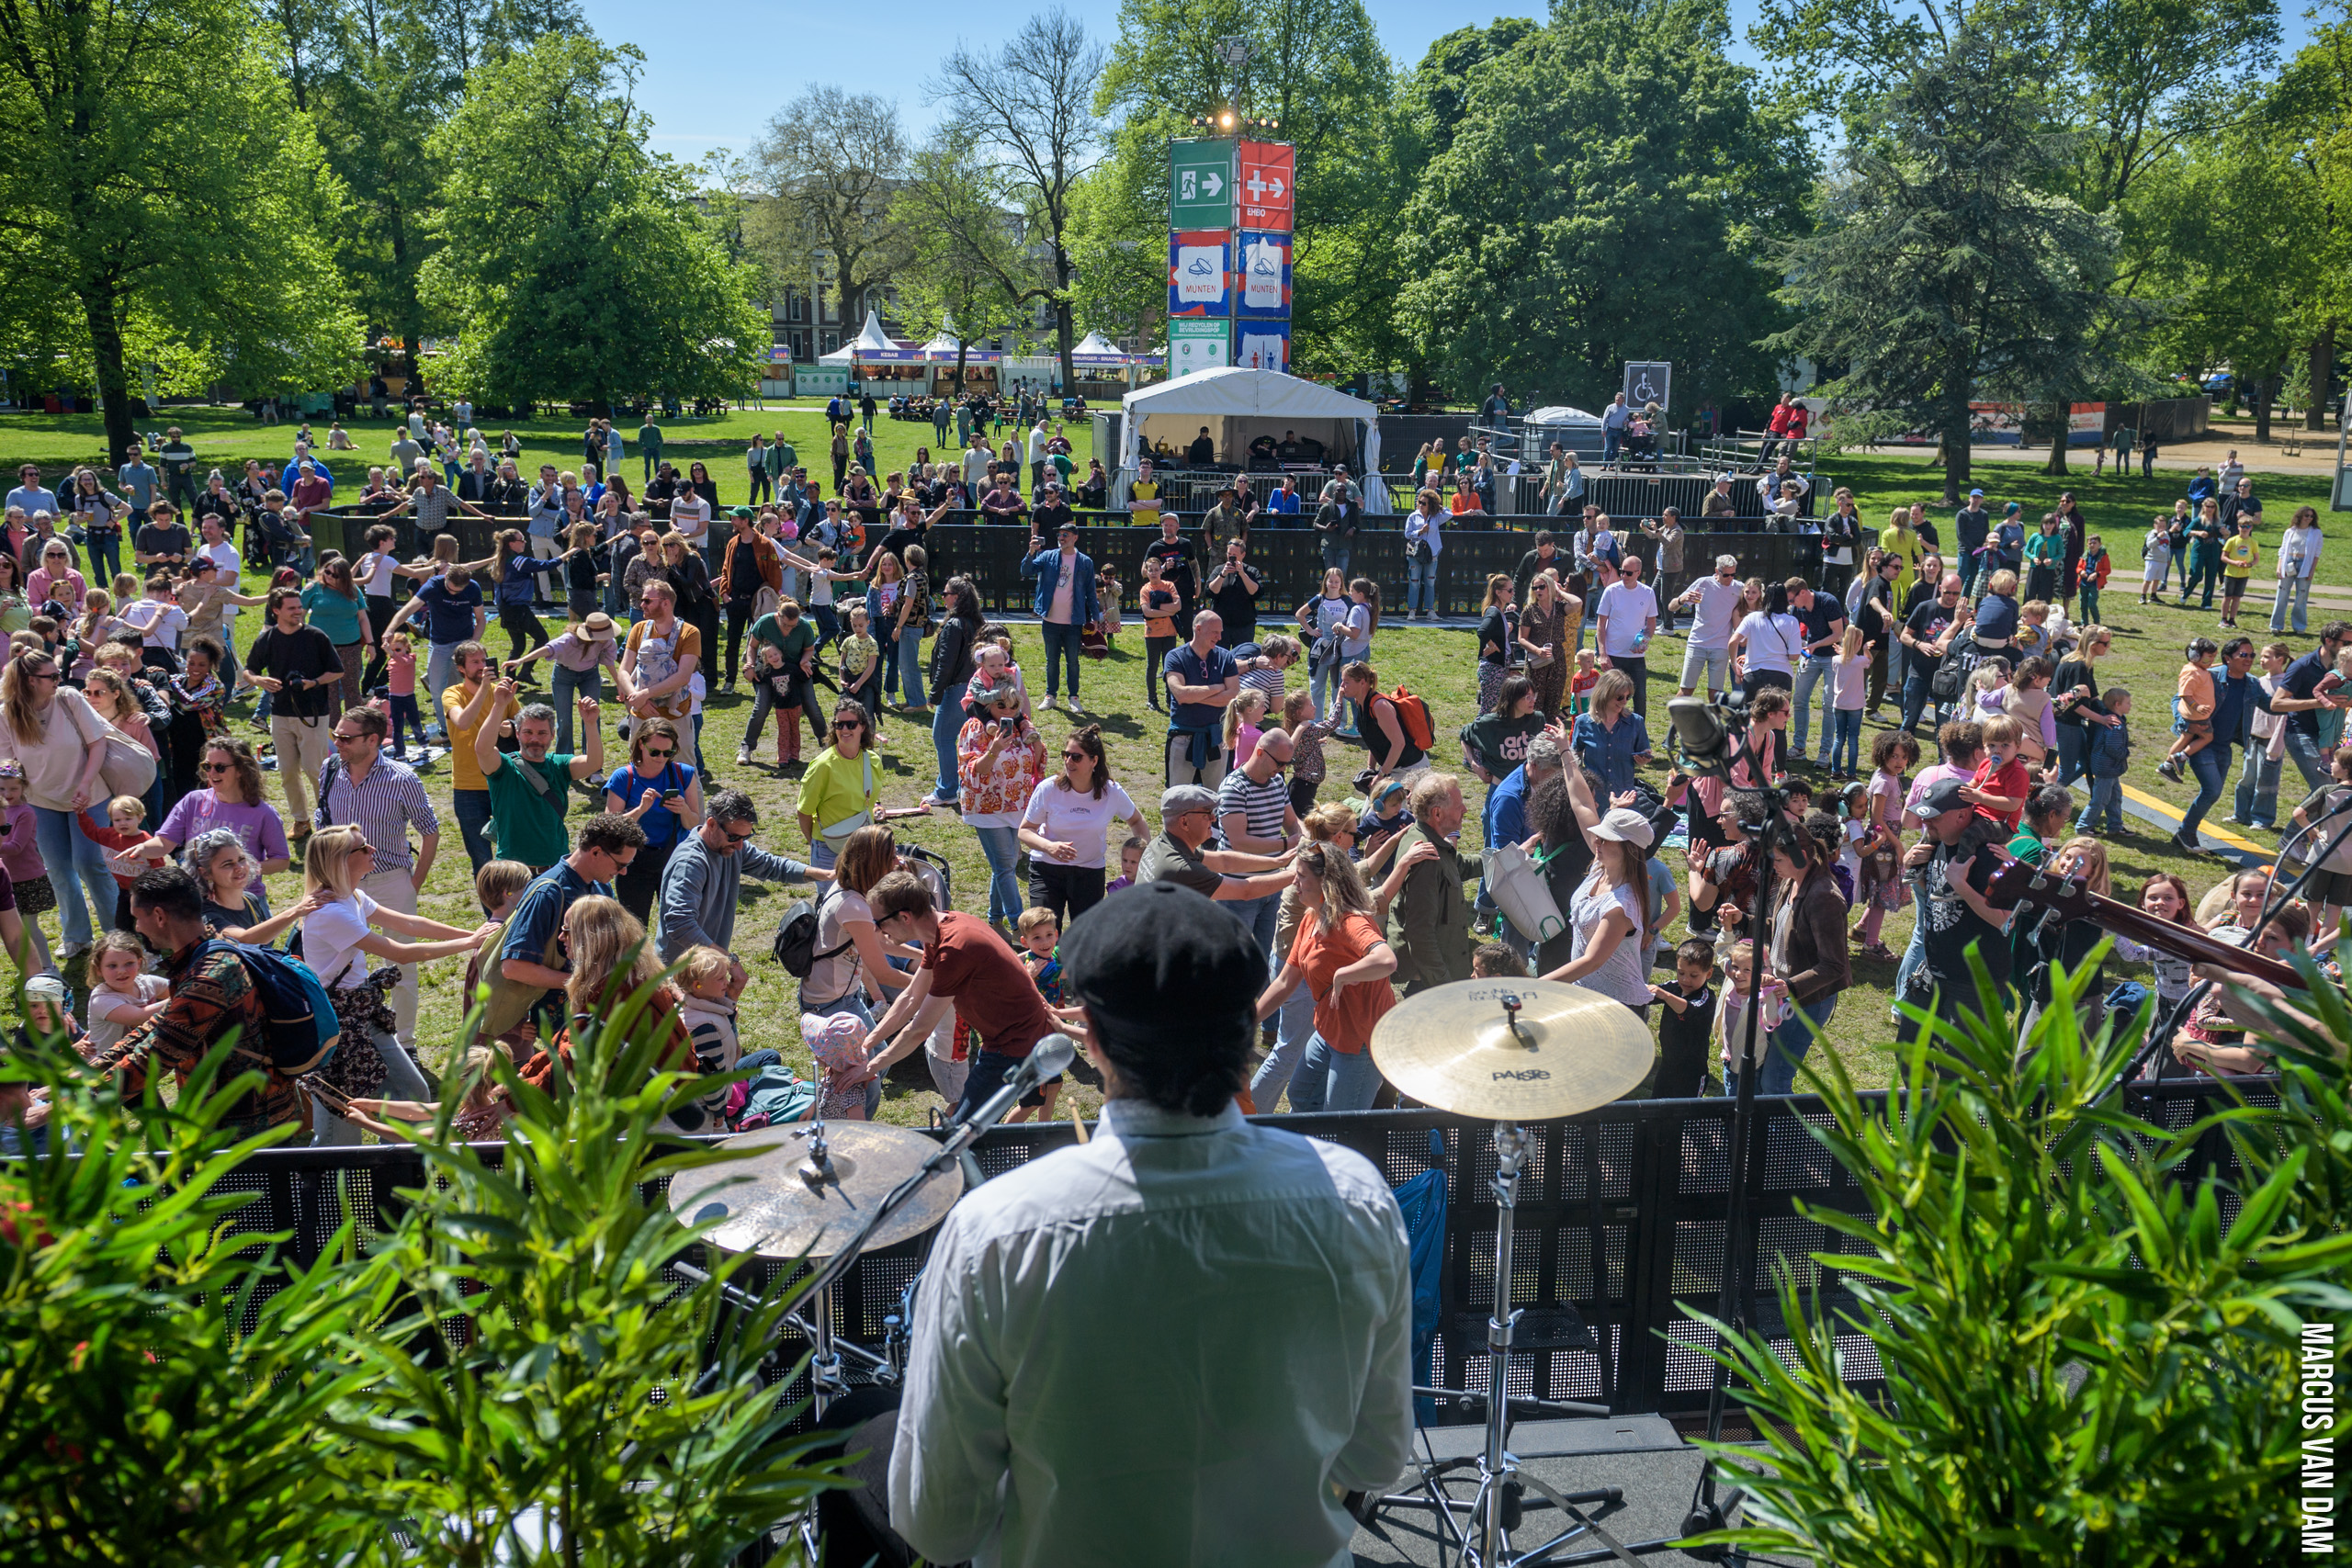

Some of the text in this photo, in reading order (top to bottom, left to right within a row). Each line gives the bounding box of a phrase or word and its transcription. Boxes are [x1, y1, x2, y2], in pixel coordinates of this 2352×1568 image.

[1247, 208, 1266, 217] EHBO
[1186, 285, 1216, 293] MUNTEN
[1250, 285, 1278, 293] MUNTEN
[1504, 730, 1529, 748] art
